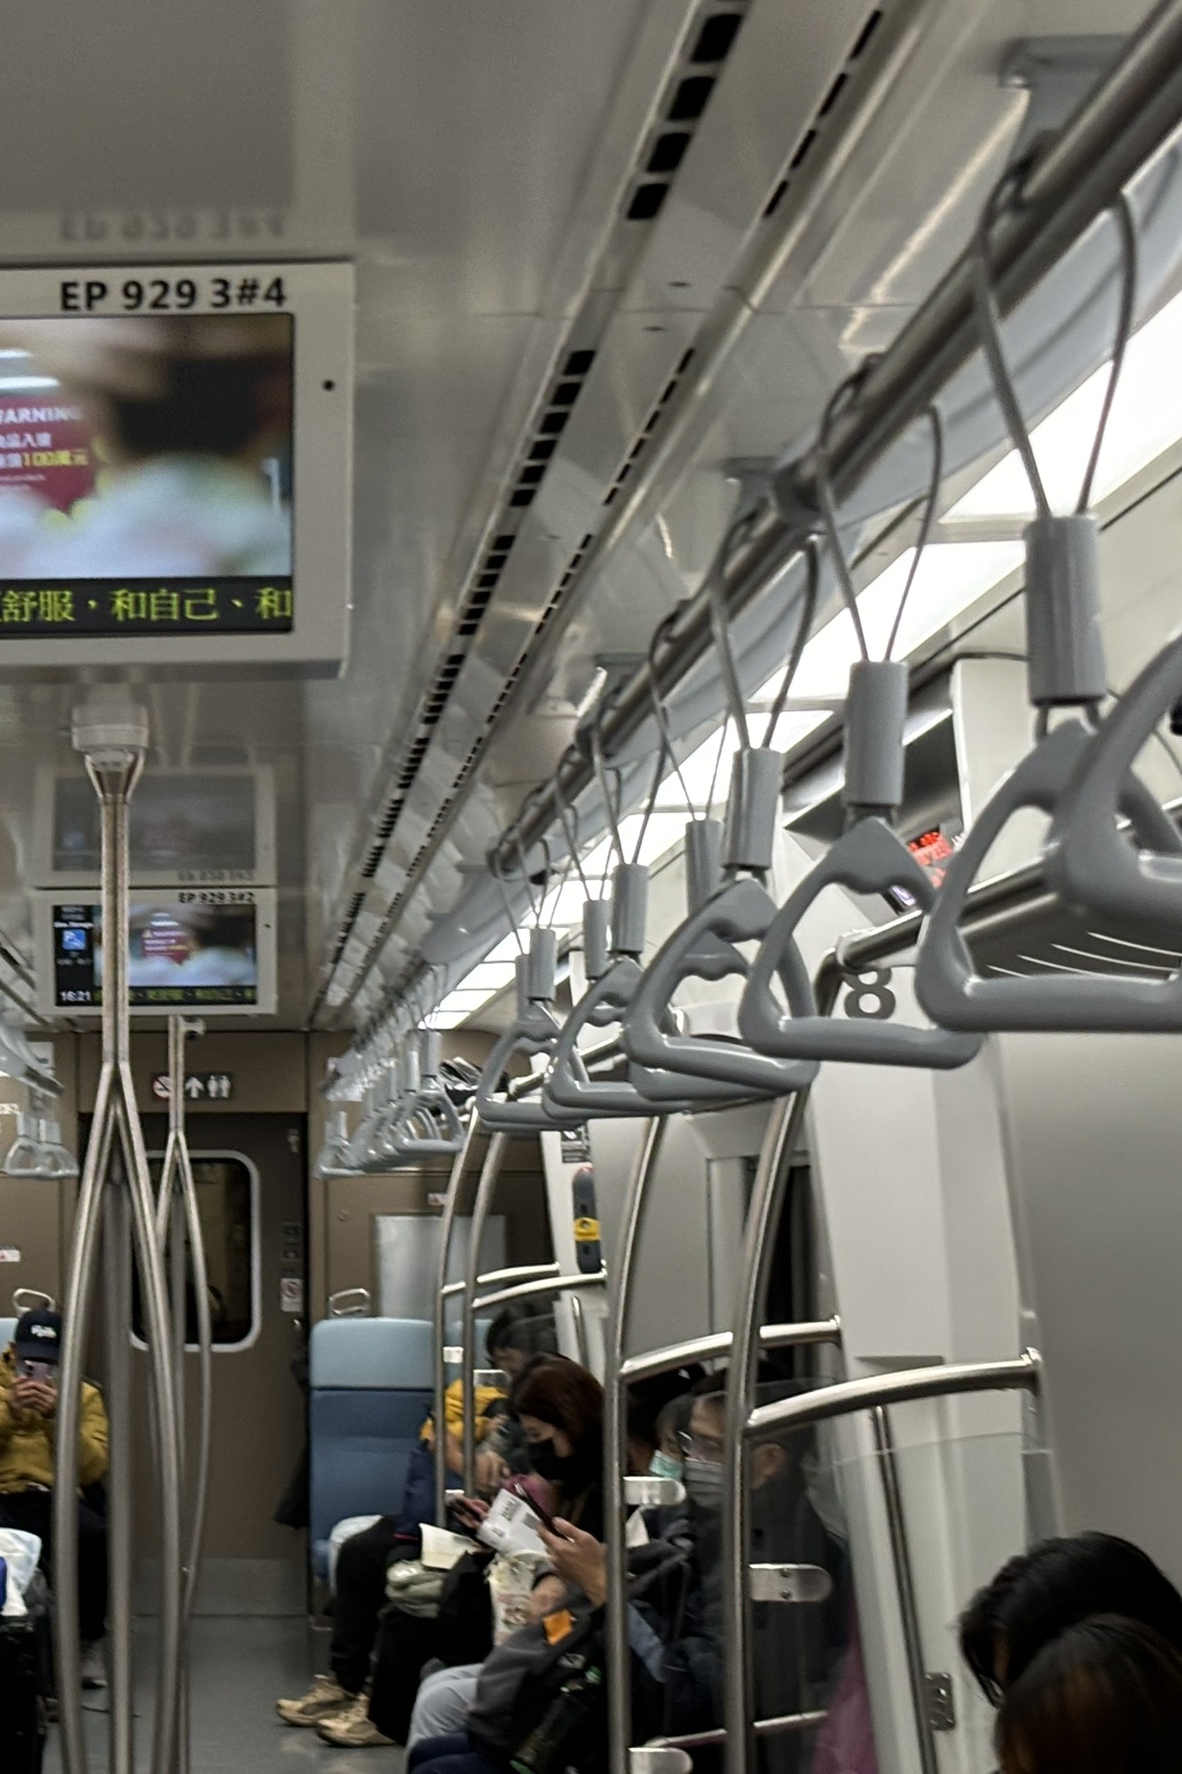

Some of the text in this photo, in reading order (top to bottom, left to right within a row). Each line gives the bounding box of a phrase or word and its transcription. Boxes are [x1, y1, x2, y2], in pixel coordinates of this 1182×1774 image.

[59, 277, 288, 311] EP 929 3#4
